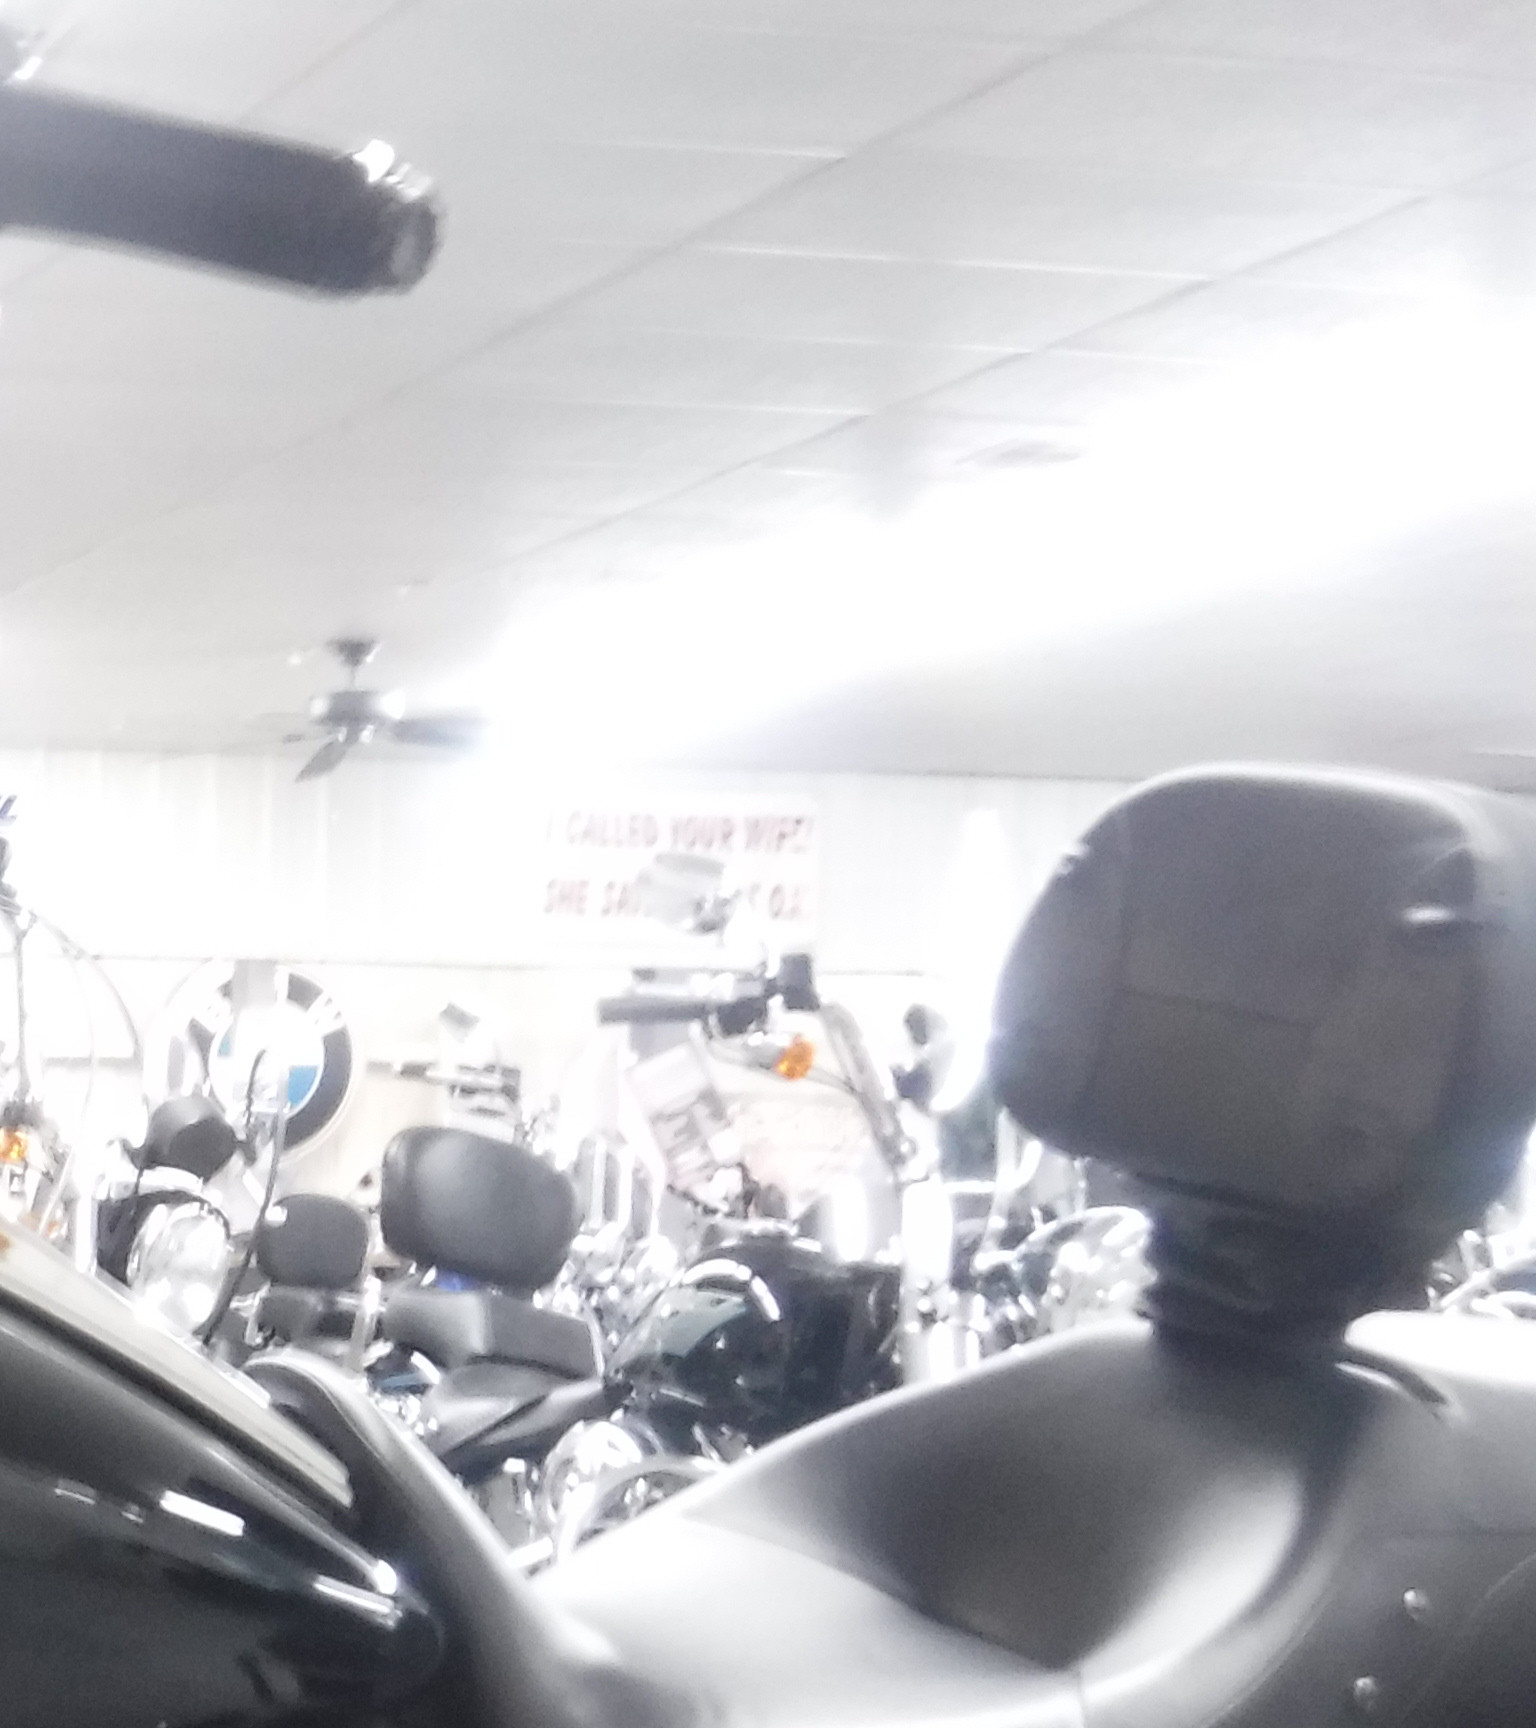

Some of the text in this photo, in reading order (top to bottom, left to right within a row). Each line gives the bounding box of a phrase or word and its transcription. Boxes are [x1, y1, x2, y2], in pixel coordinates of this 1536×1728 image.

[565, 808, 659, 847] CALLED
[670, 812, 736, 850] YOUR
[543, 878, 590, 916] SHE
